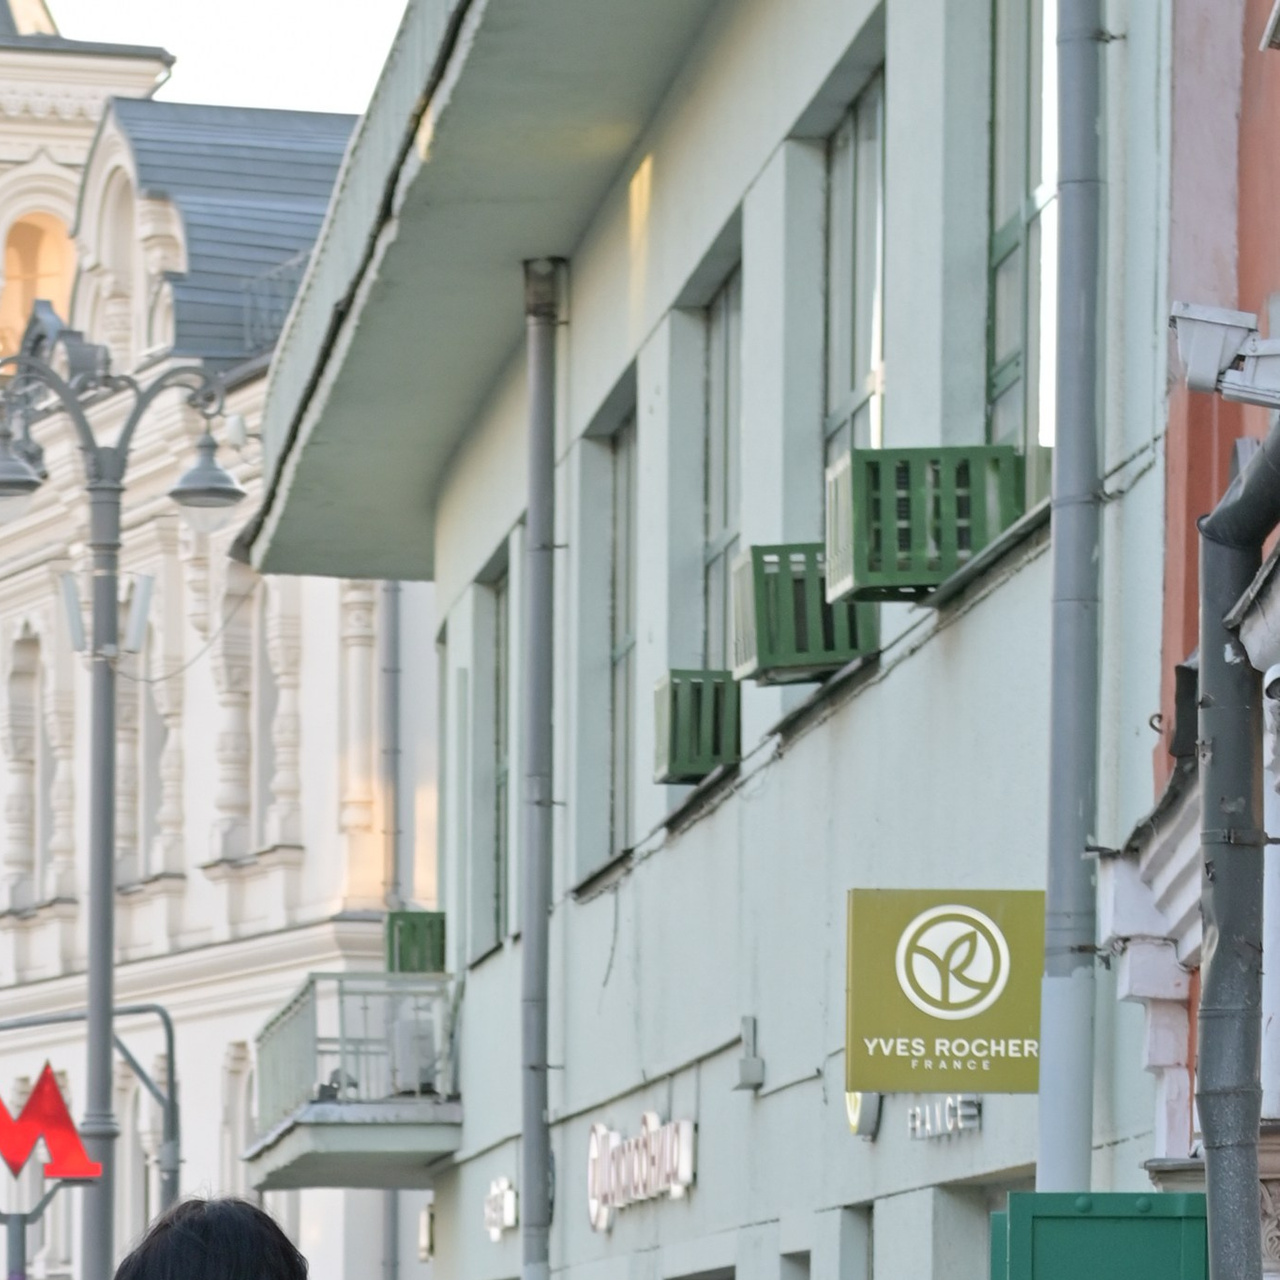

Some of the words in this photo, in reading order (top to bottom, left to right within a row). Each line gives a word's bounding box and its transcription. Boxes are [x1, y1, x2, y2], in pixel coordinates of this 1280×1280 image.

[863, 1037, 926, 1057] YVES
[934, 1037, 1040, 1059] ROCHER
[910, 1059, 991, 1071] FRANCE
